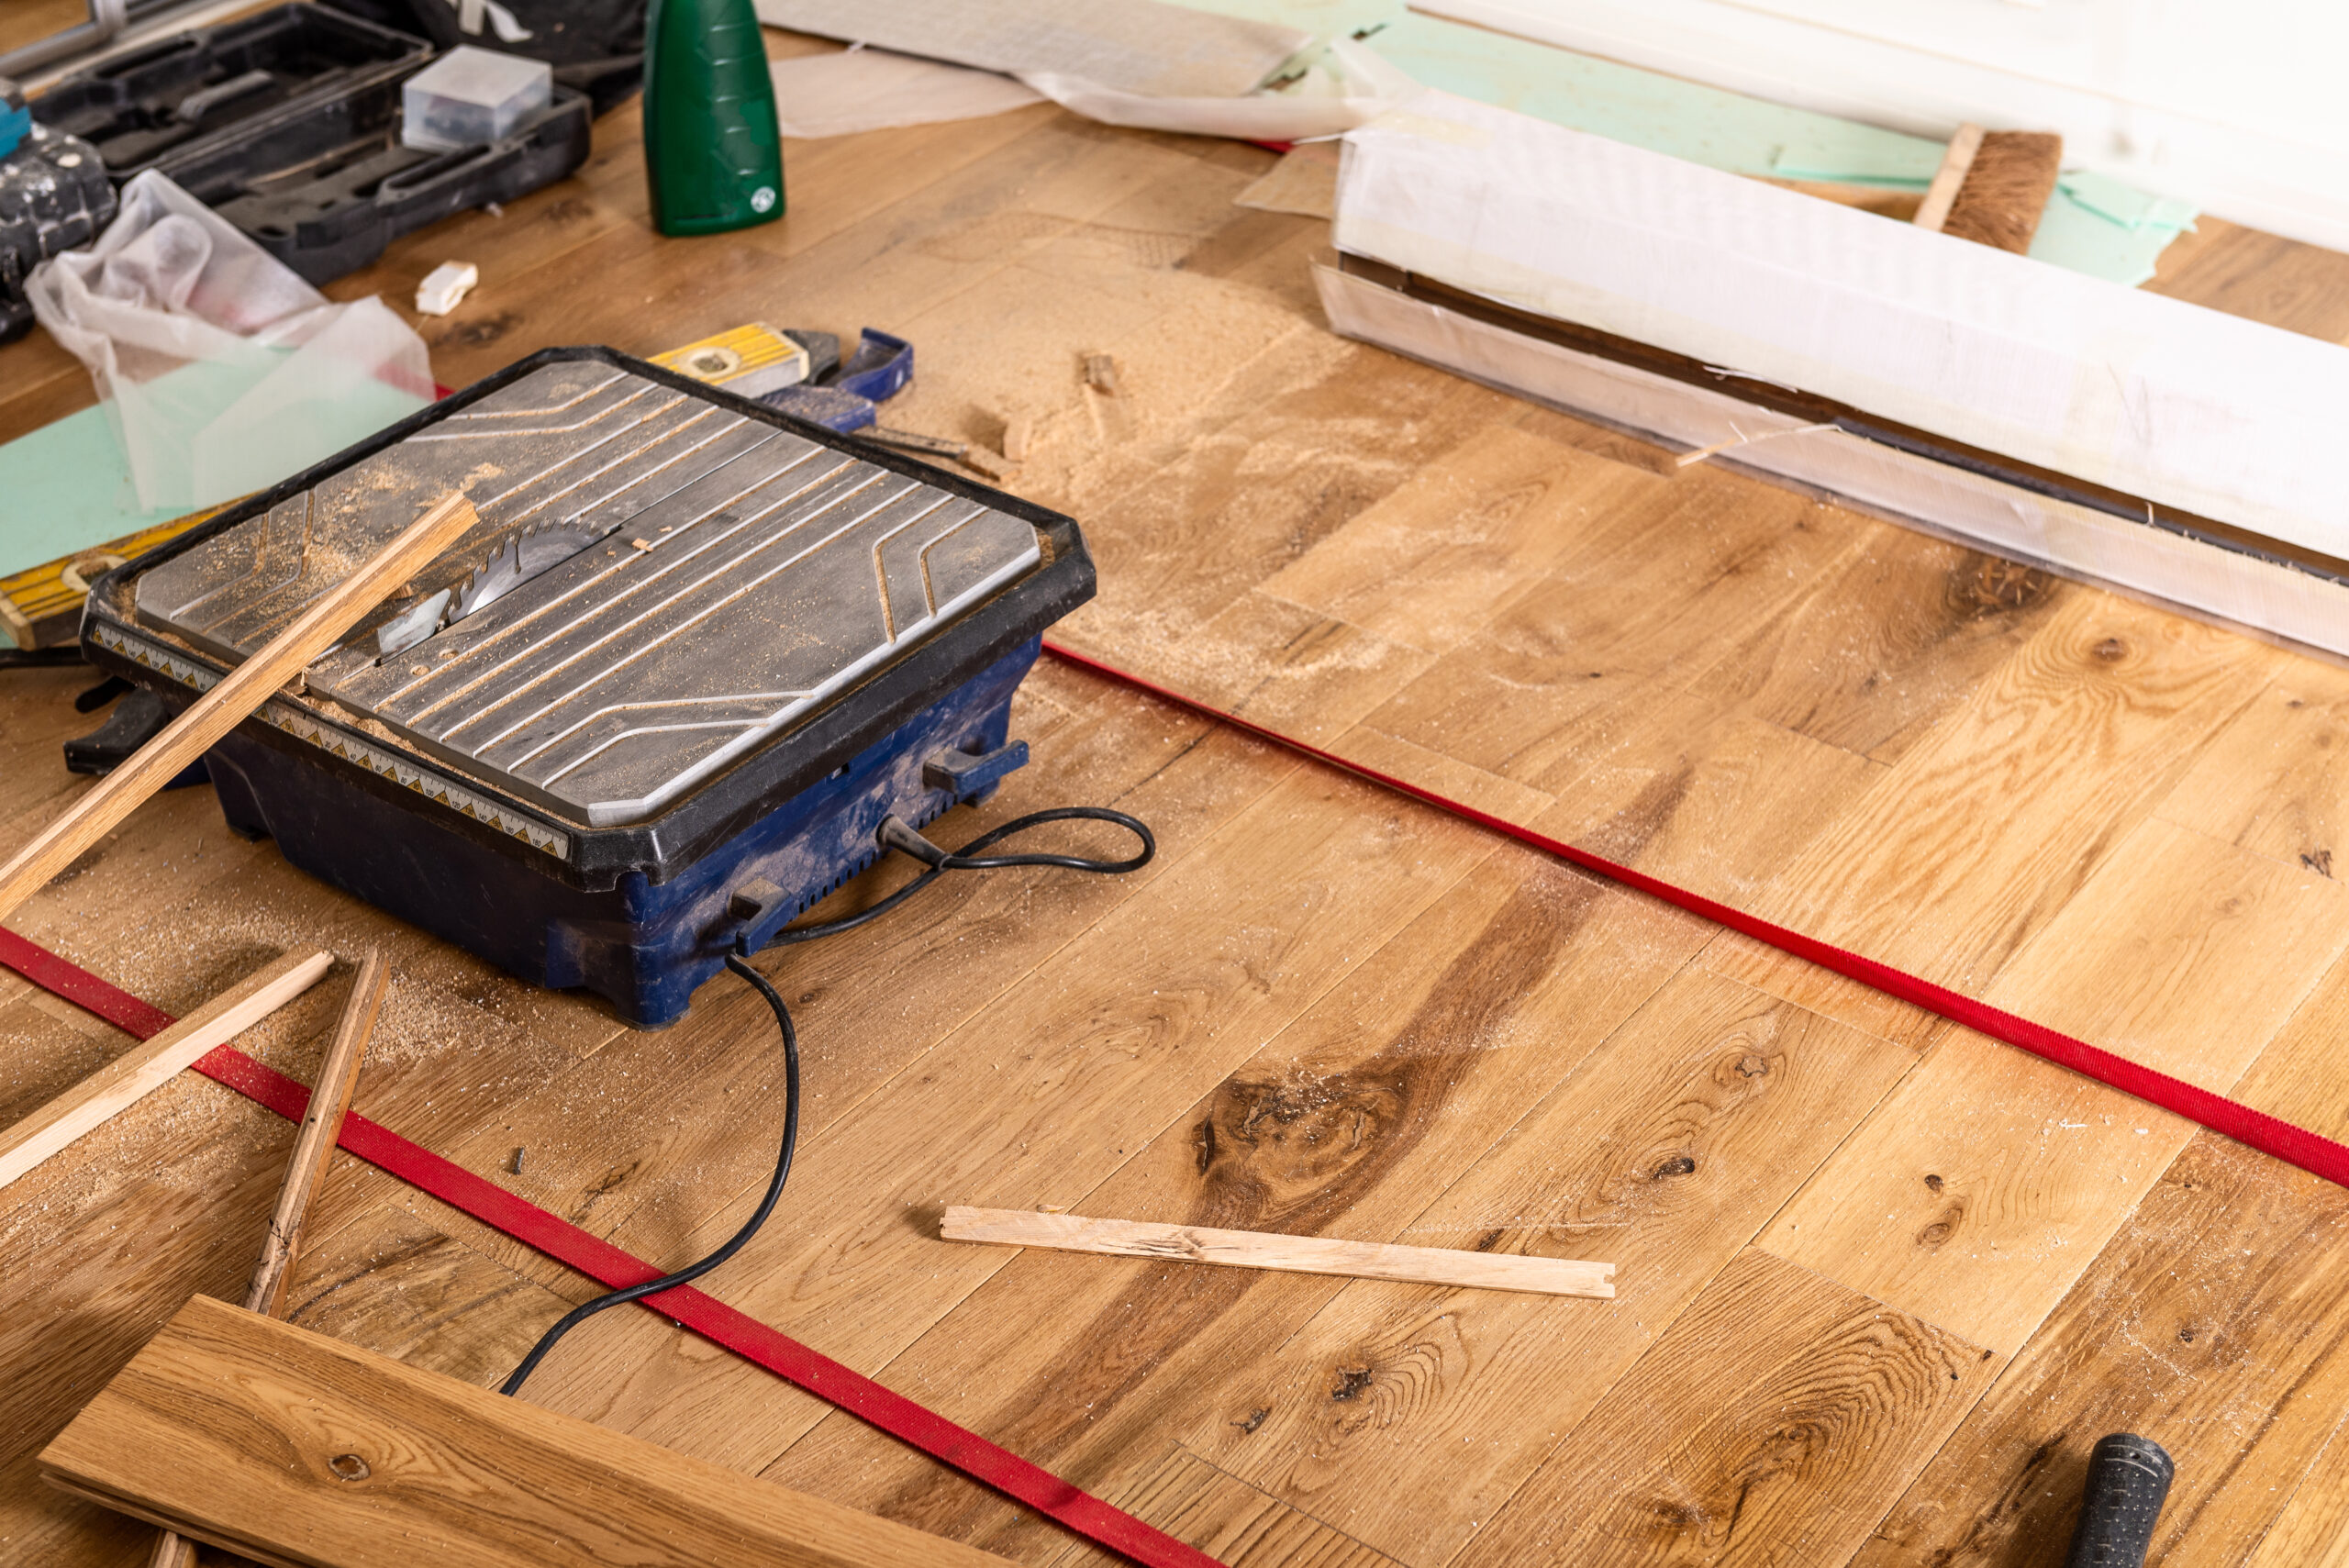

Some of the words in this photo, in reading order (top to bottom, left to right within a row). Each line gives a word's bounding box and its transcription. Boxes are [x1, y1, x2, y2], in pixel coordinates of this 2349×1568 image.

[426, 788, 434, 796] 100
[452, 800, 461, 808] 120
[478, 813, 486, 822] 140
[532, 838, 541, 847] 180
